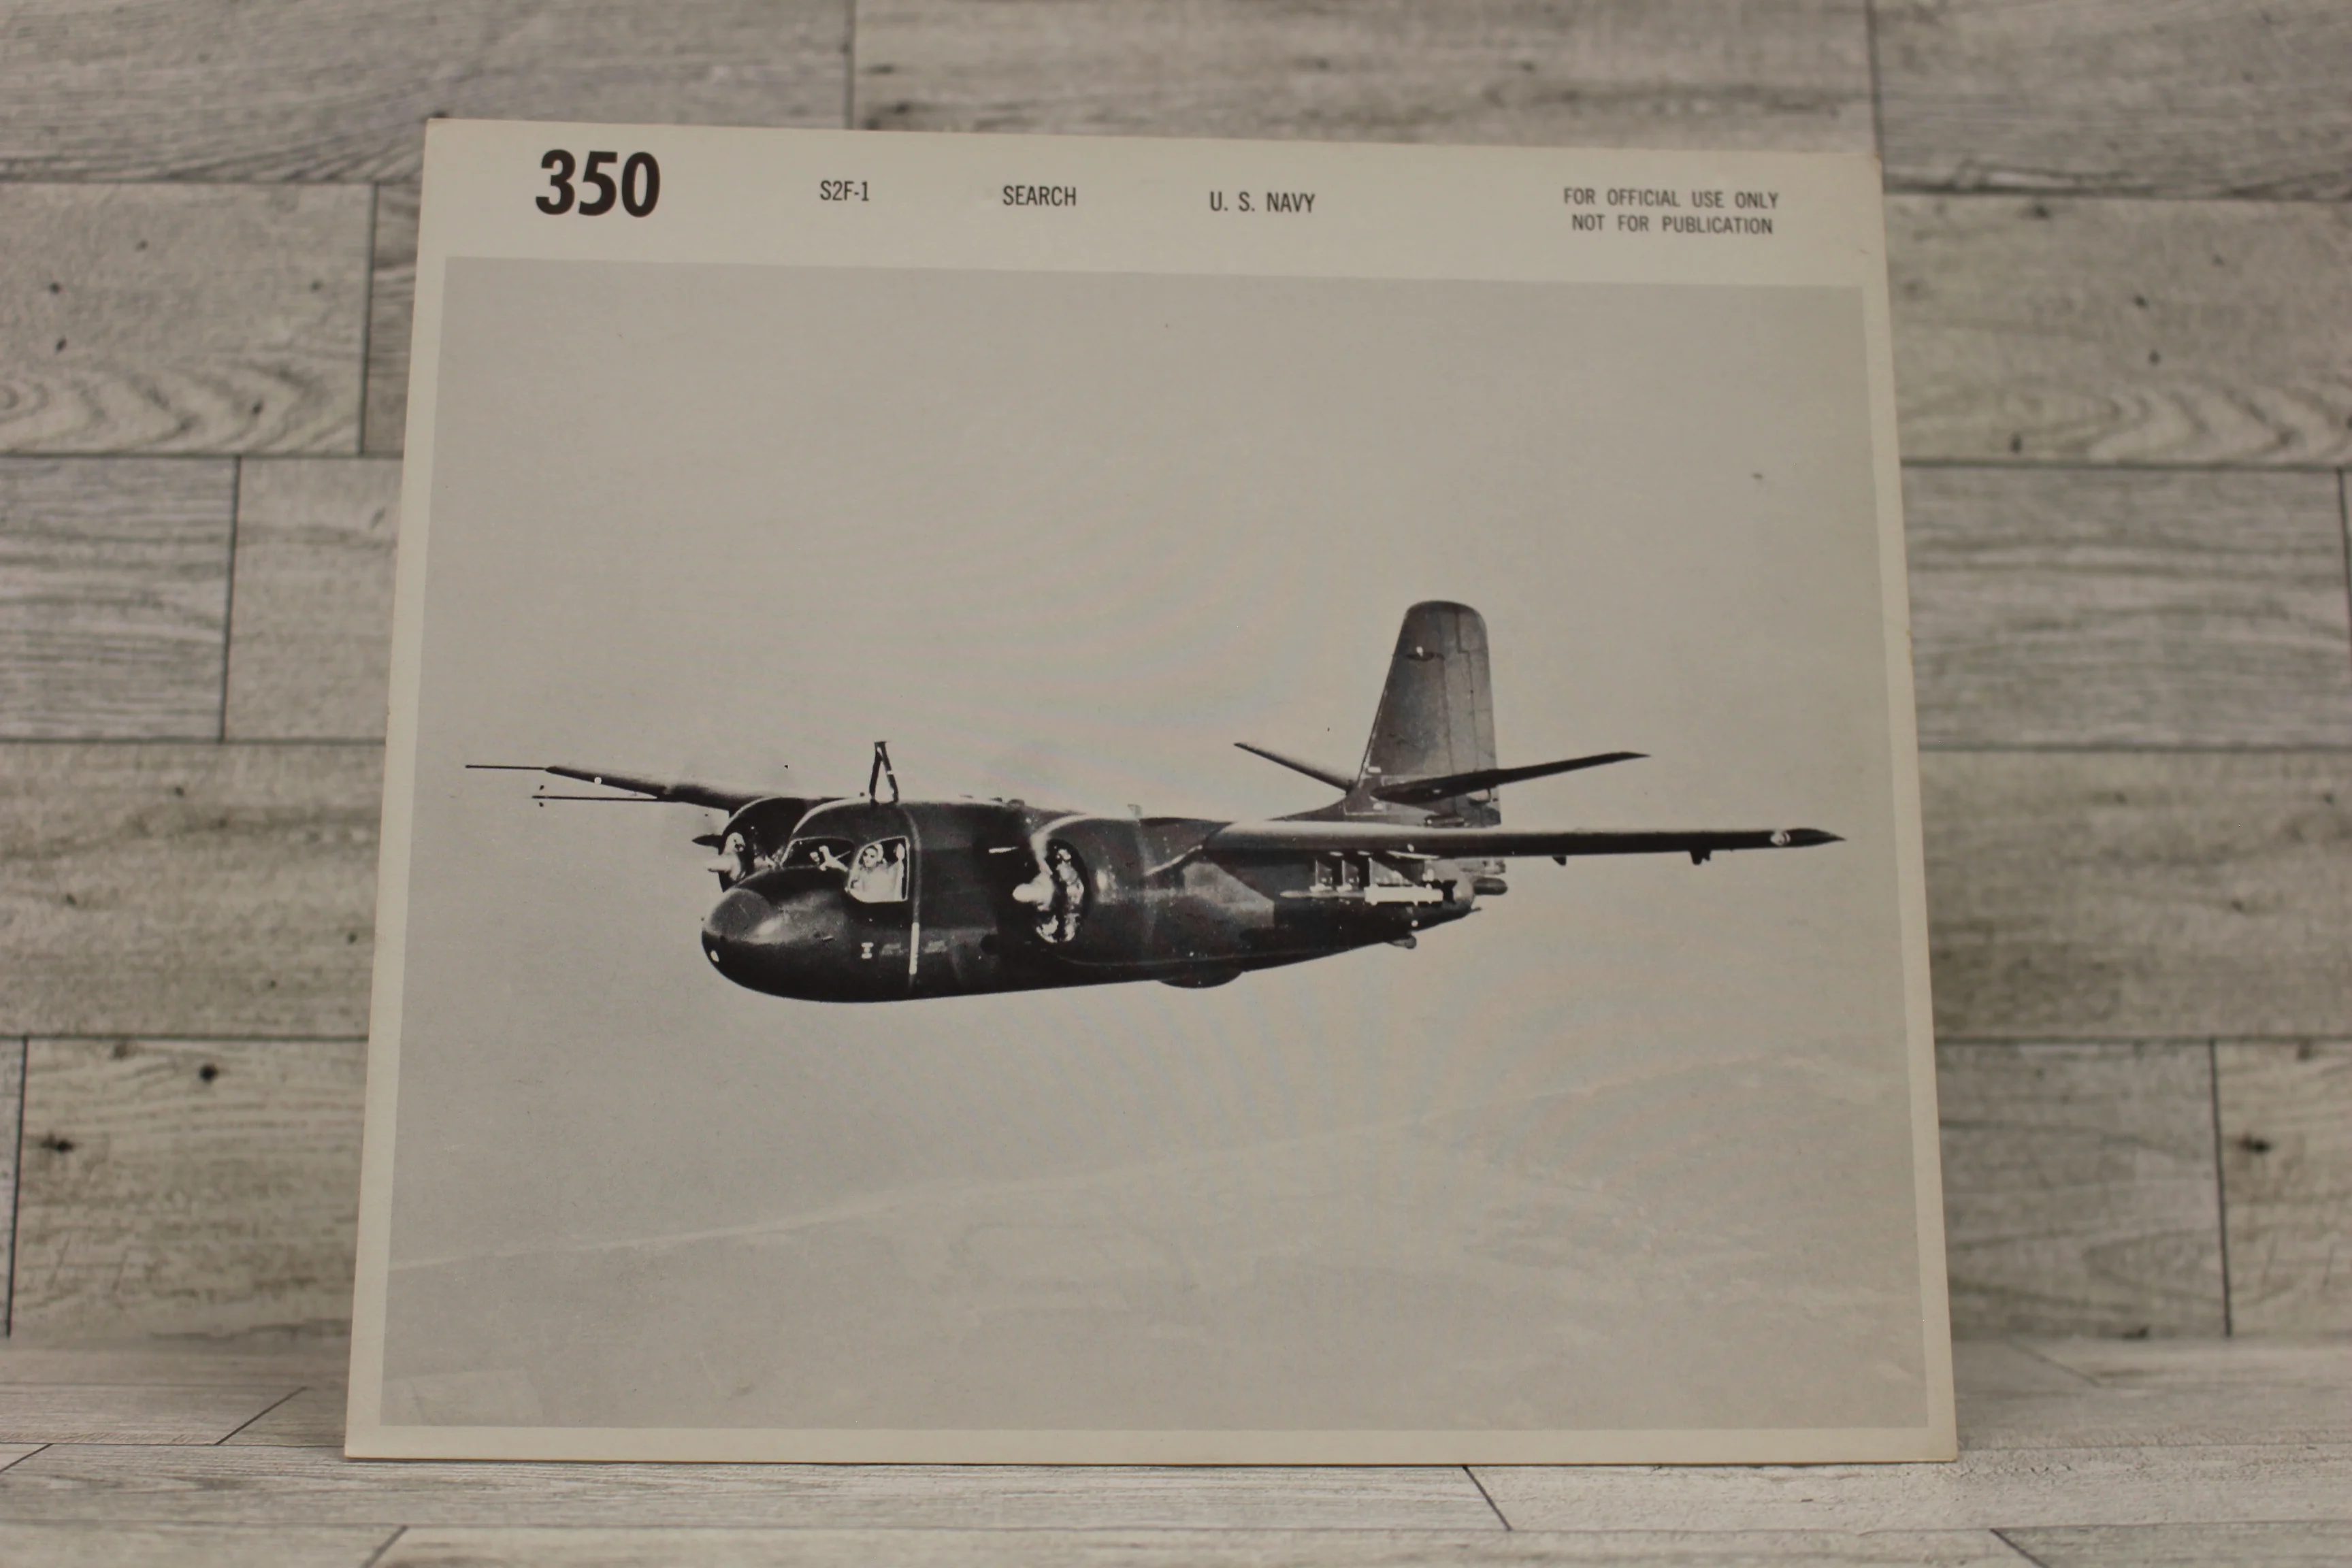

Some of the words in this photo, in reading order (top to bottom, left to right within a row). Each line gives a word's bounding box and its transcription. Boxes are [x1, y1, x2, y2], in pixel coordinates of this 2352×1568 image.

[535, 148, 661, 218] 350
[819, 180, 870, 202] S2F-1
[1002, 184, 1077, 207] SEARCH
[1209, 191, 1228, 212] U.
[1238, 191, 1256, 213] S.
[1266, 192, 1316, 214] NAVY
[1563, 187, 1596, 205] FOR
[1607, 189, 1680, 207] OFFICIAL
[1691, 191, 1725, 208] USE
[1735, 191, 1779, 209] ONLY
[1571, 214, 1605, 231] NOT
[1617, 215, 1650, 232] FOR
[1661, 216, 1774, 234] PUBLICATION
